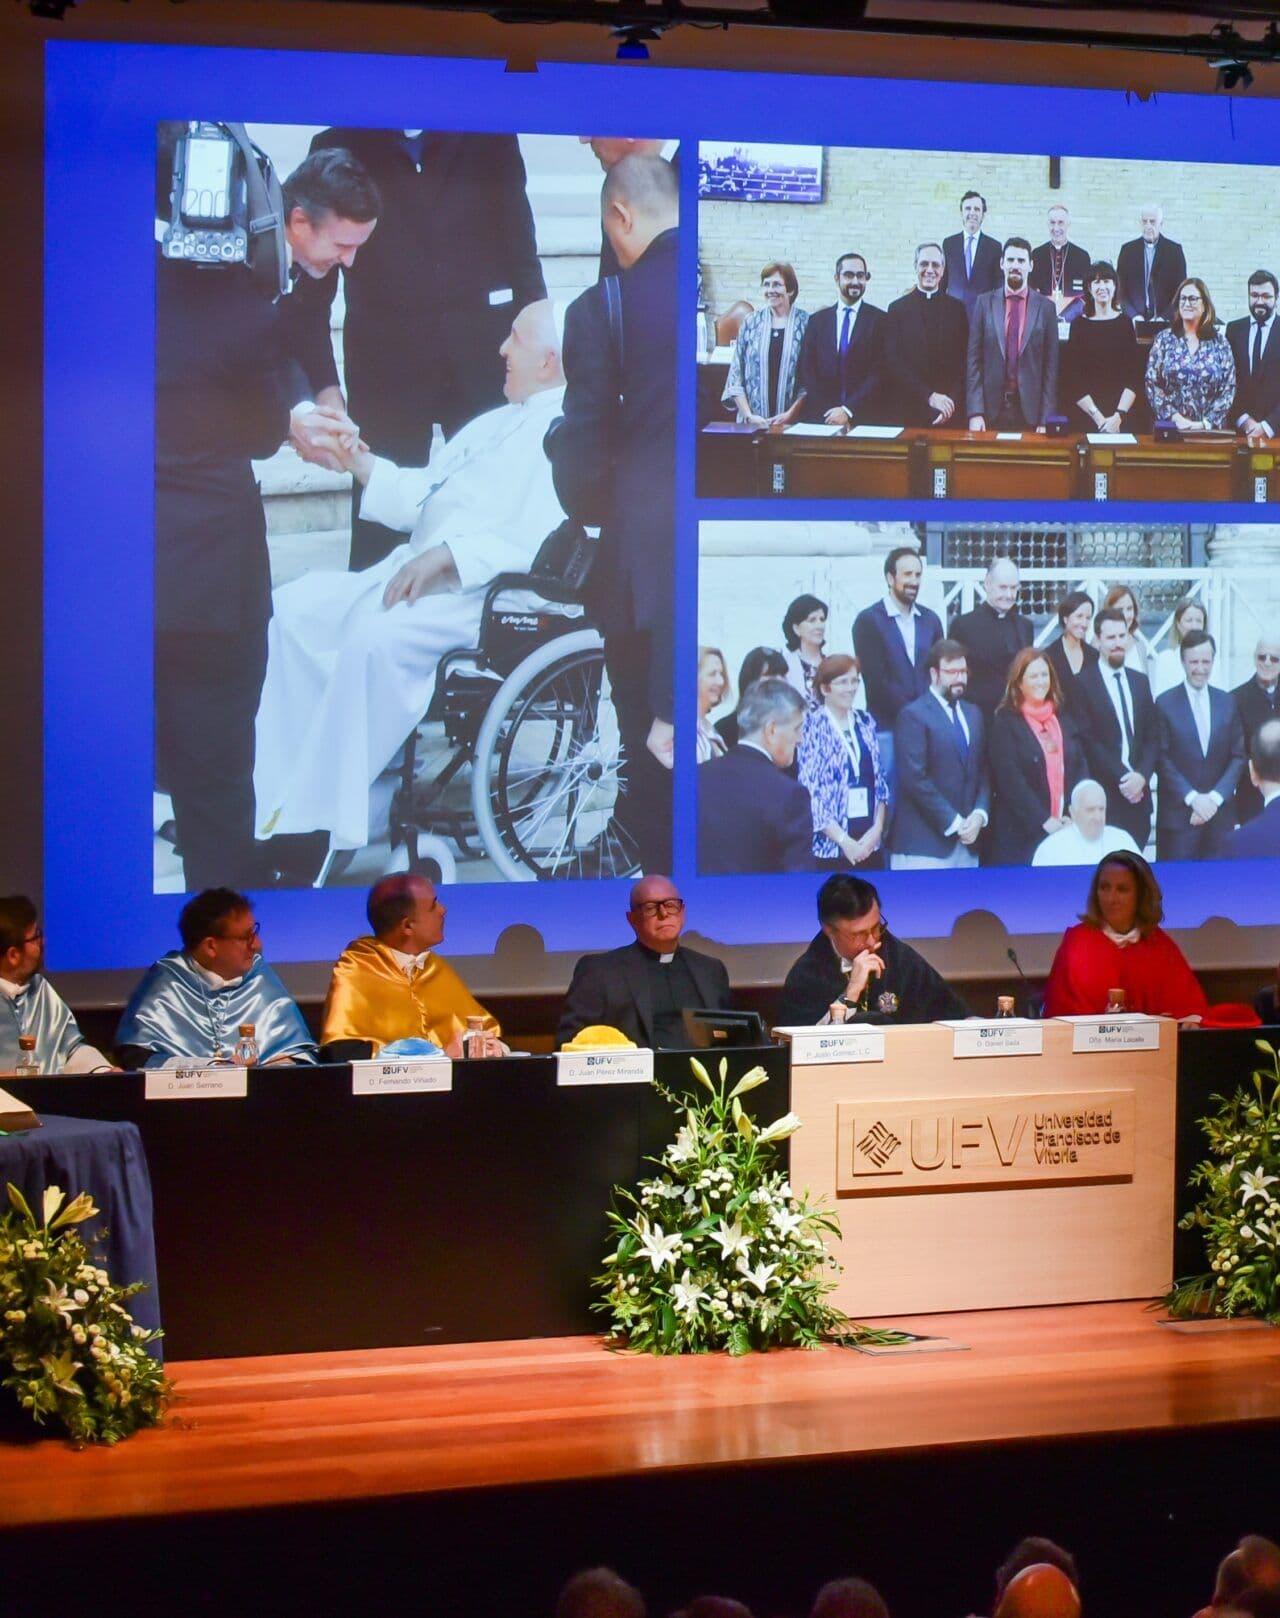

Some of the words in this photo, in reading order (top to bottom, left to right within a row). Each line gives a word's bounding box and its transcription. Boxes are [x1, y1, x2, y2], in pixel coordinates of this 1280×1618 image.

[987, 1029, 1004, 1037] UFV
[828, 1039, 844, 1047] UFV
[595, 1057, 613, 1065] UFV
[391, 1066, 409, 1074] UFV
[616, 1067, 644, 1075] Miranda
[184, 1070, 203, 1079] UFV
[378, 1077, 410, 1085] Fernando
[1034, 1110, 1113, 1130] Universidad
[1034, 1129, 1101, 1147] Francisco
[1103, 1127, 1121, 1145] de
[910, 1113, 1029, 1171] UFV
[1034, 1147, 1079, 1165] Vitoria
